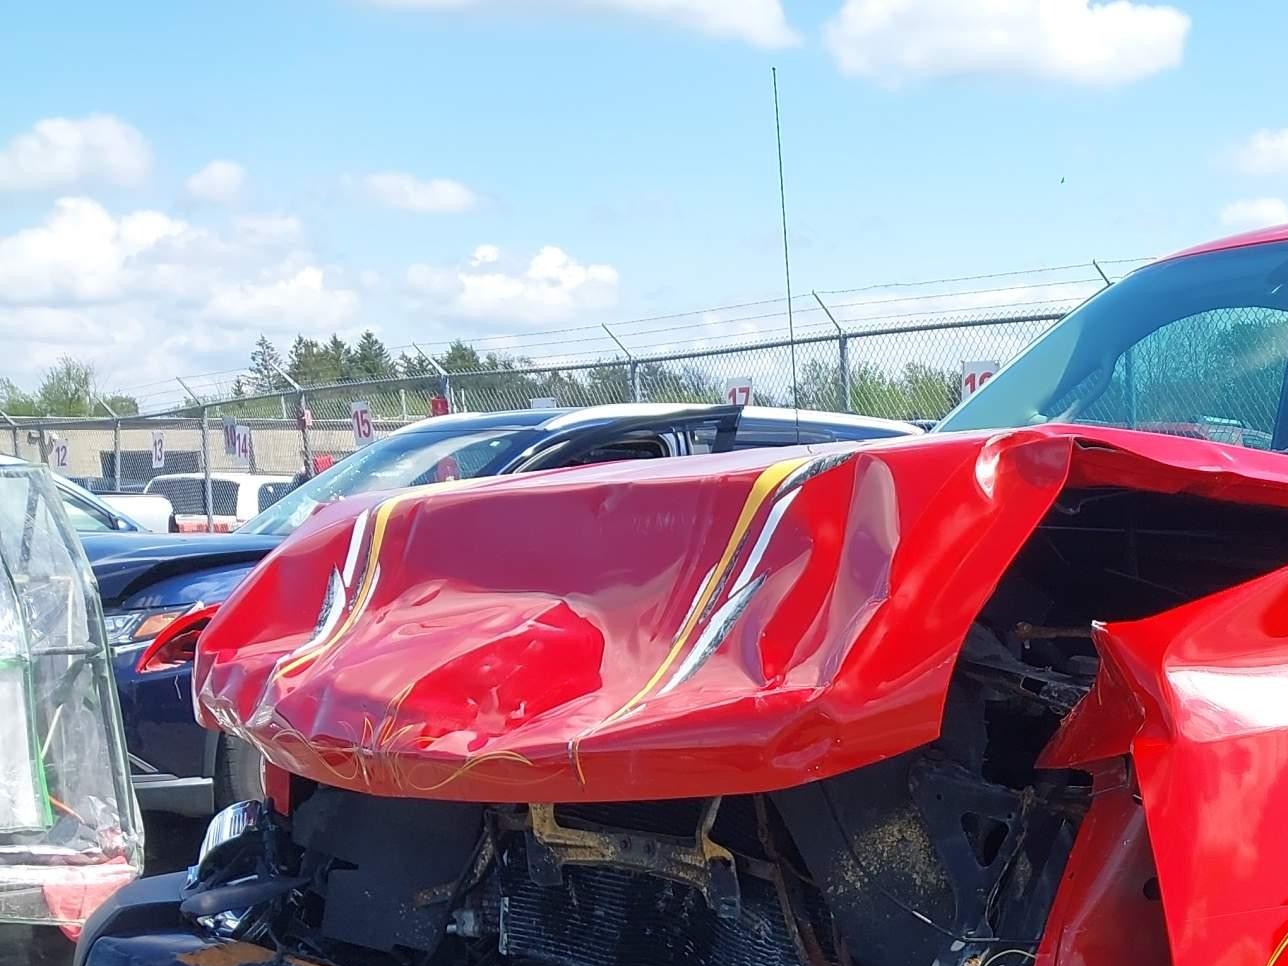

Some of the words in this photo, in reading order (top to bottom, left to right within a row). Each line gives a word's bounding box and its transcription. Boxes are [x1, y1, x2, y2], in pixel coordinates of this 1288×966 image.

[728, 386, 750, 405] 17
[353, 409, 371, 438] 15
[56, 445, 67, 466] 12
[153, 438, 163, 462] 13
[237, 432, 248, 458] 14
